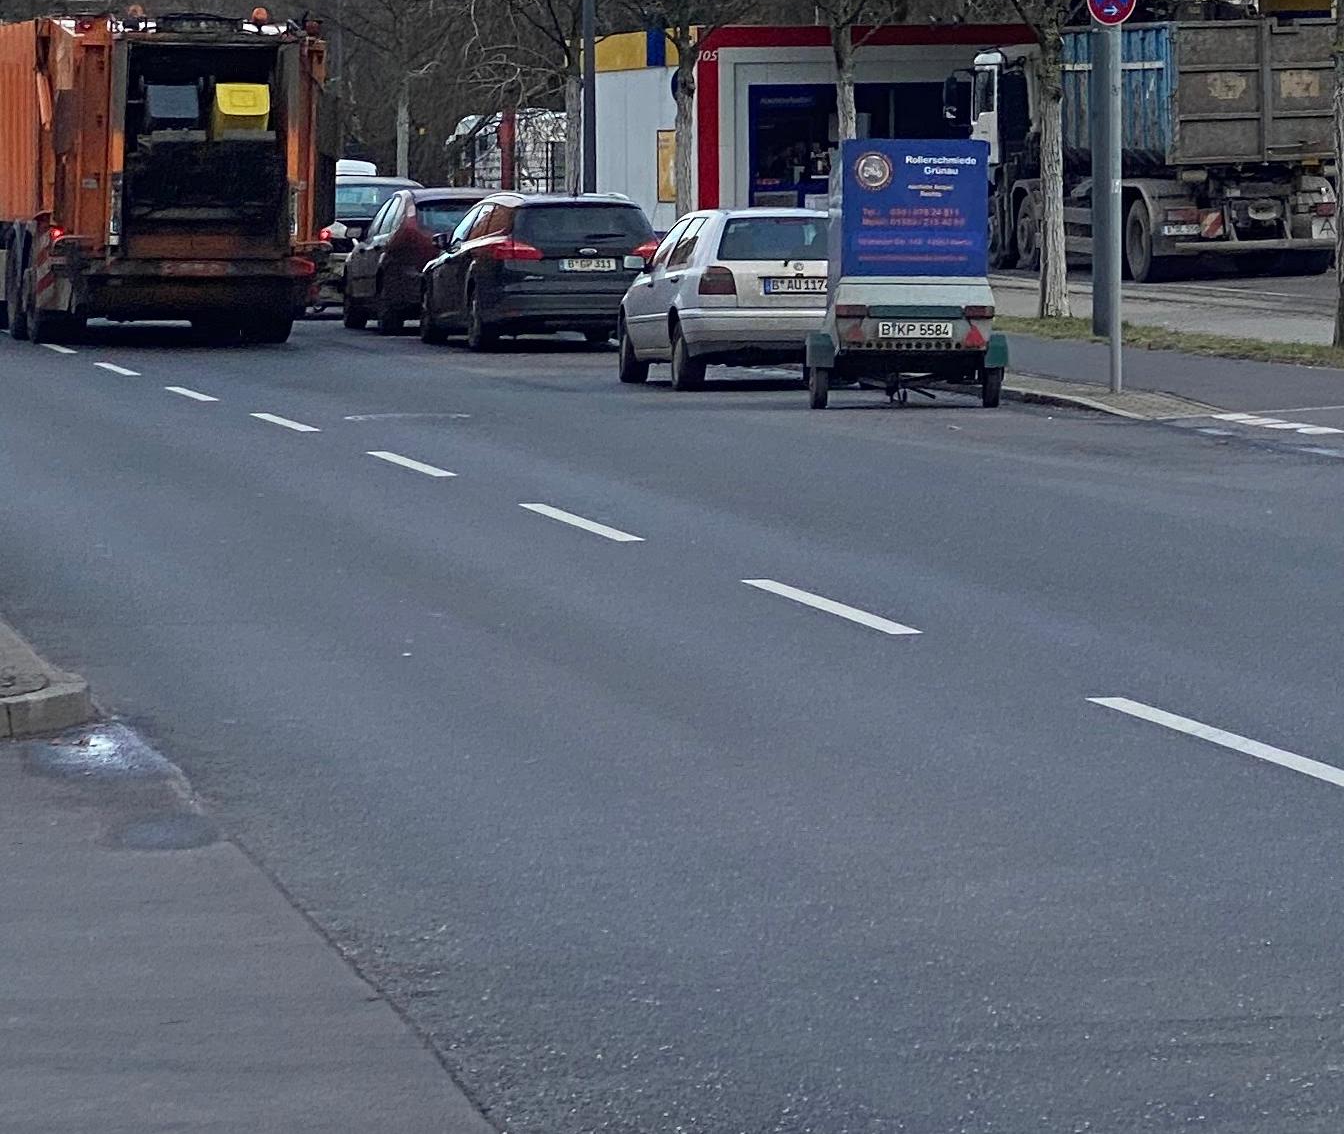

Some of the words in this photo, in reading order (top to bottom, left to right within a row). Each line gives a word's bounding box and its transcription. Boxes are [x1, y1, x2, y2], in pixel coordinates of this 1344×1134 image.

[905, 155, 977, 165] Rollerschmiede
[924, 166, 959, 175] Grünau
[881, 324, 891, 336] B
[897, 324, 916, 336] KP
[919, 324, 950, 336] 5584
